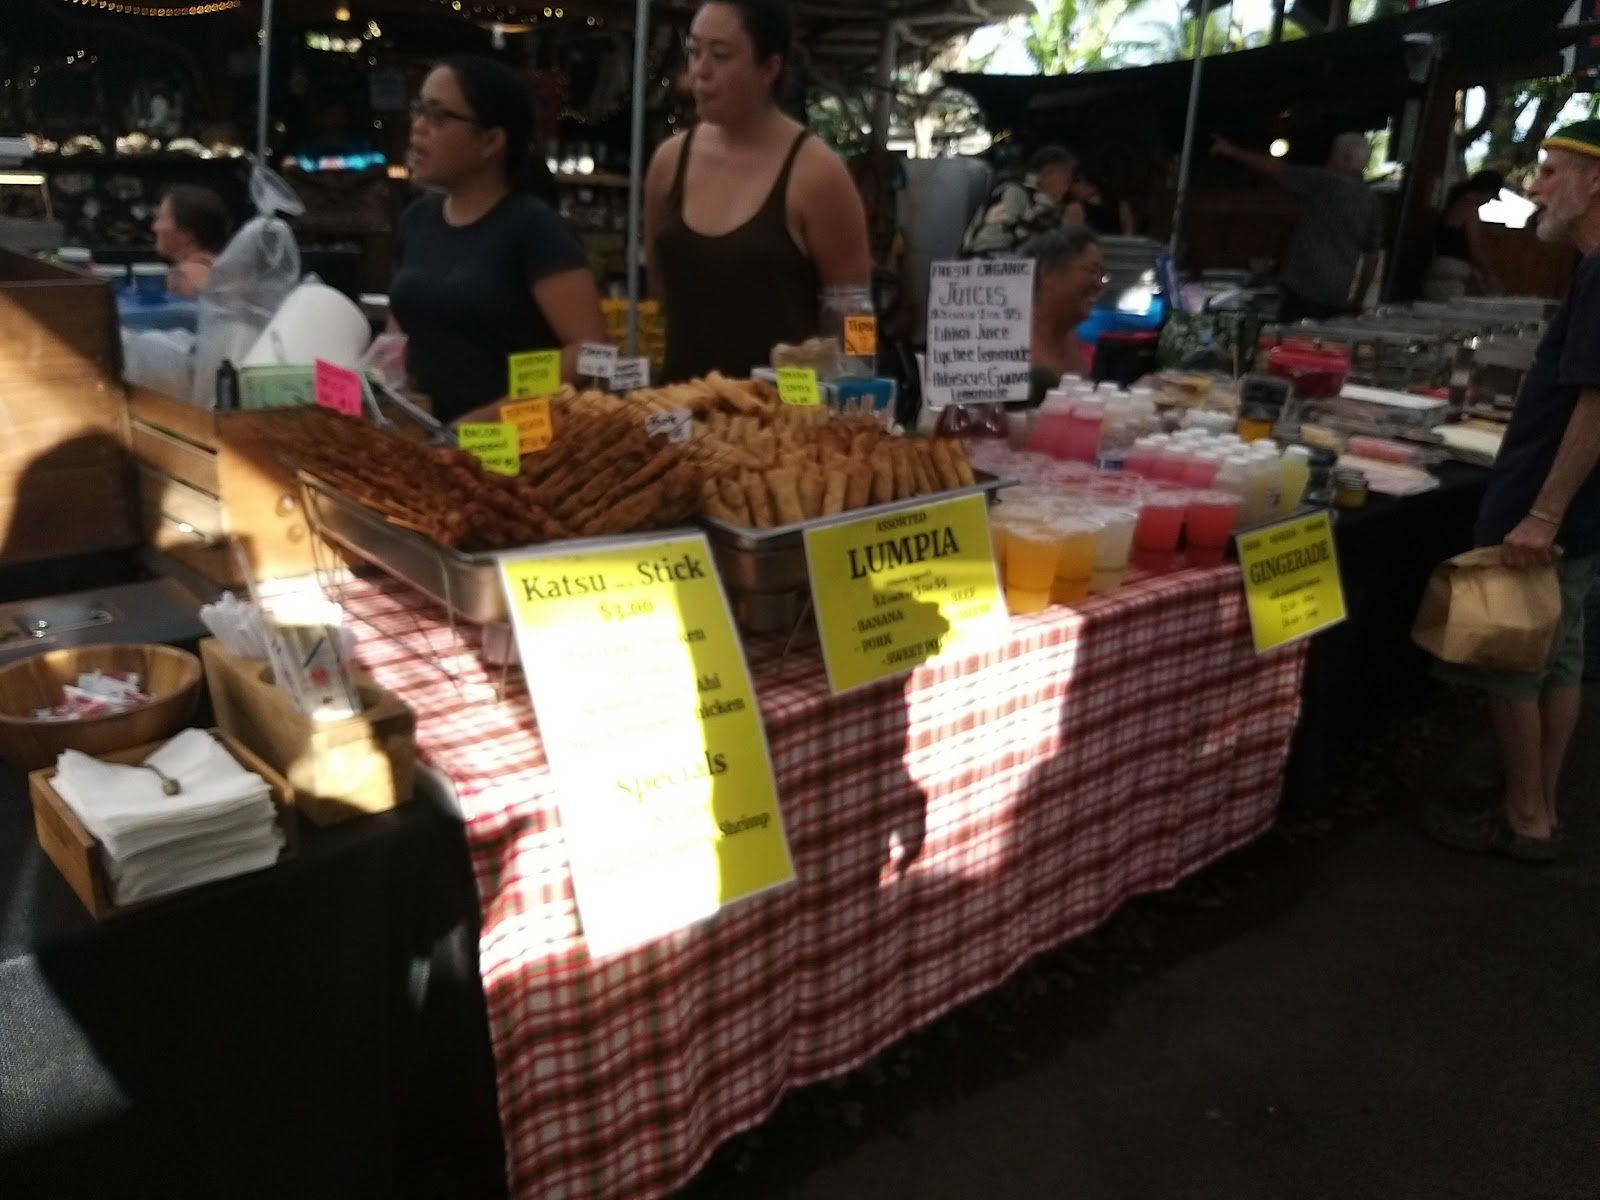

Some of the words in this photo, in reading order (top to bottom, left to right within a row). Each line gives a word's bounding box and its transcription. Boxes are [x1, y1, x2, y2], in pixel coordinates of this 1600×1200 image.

[977, 262, 1029, 277] ORGANIC
[876, 511, 927, 532] ASSORTED
[848, 527, 960, 580] LUMPIA
[1249, 539, 1329, 585] GINGERADE
[520, 574, 608, 602] Katsu
[637, 554, 706, 585] Stick
[697, 697, 747, 718] hicken
[719, 811, 771, 838] Shrimp
